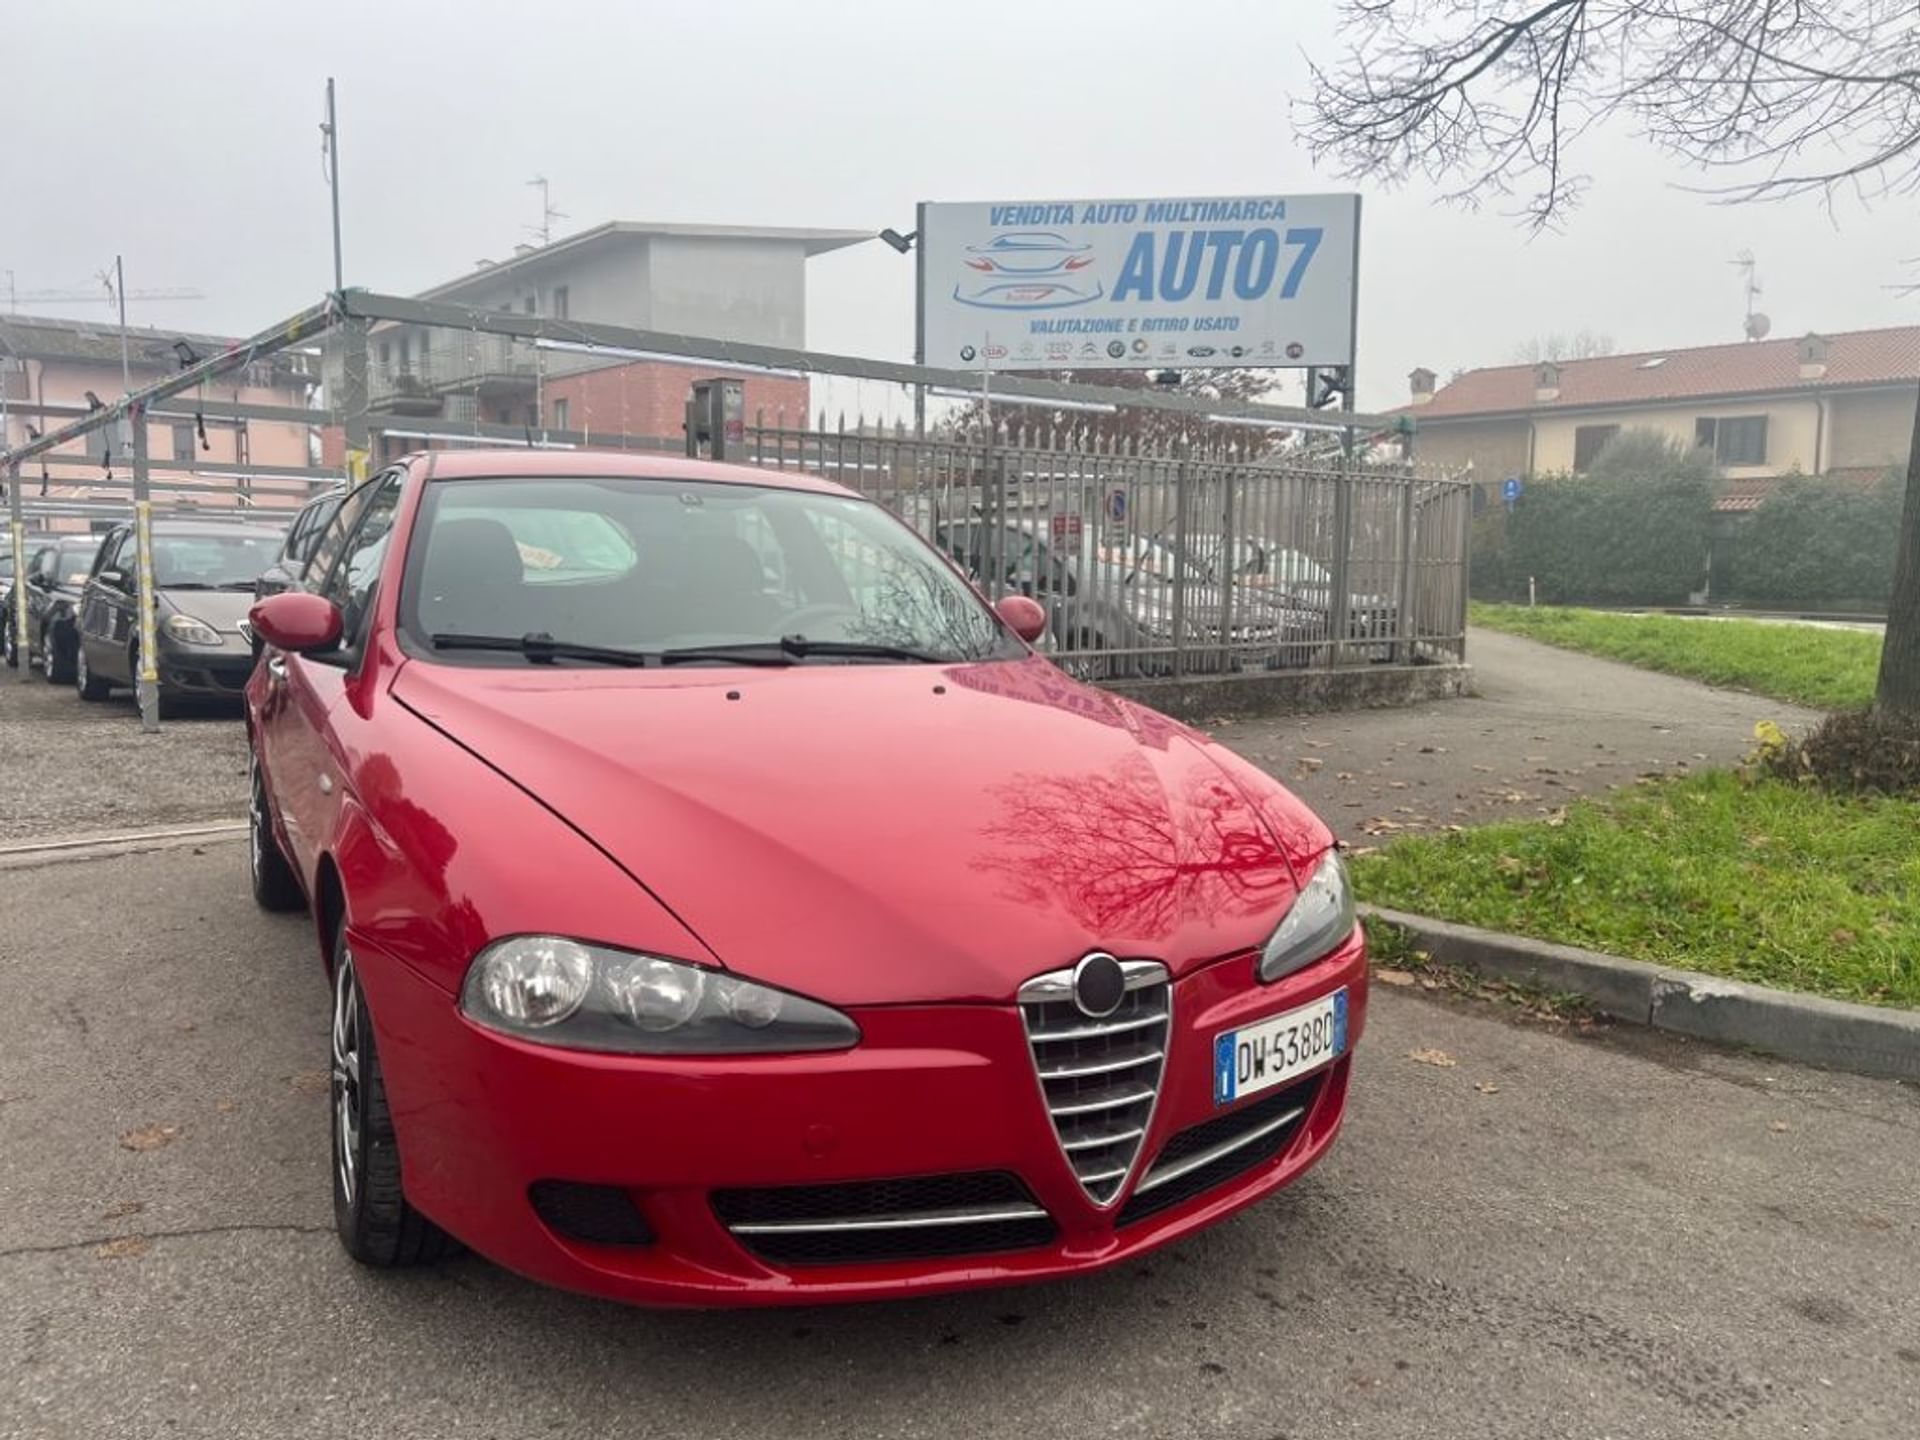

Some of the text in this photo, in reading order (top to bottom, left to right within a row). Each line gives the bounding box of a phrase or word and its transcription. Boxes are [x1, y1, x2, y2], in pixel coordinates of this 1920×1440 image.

[990, 200, 1286, 226] VENDITA AUTO MULTIMARCA
[1110, 228, 1324, 302] AUTO7
[1030, 316, 1240, 335] VALUTAZIONE E RITIRO USATO
